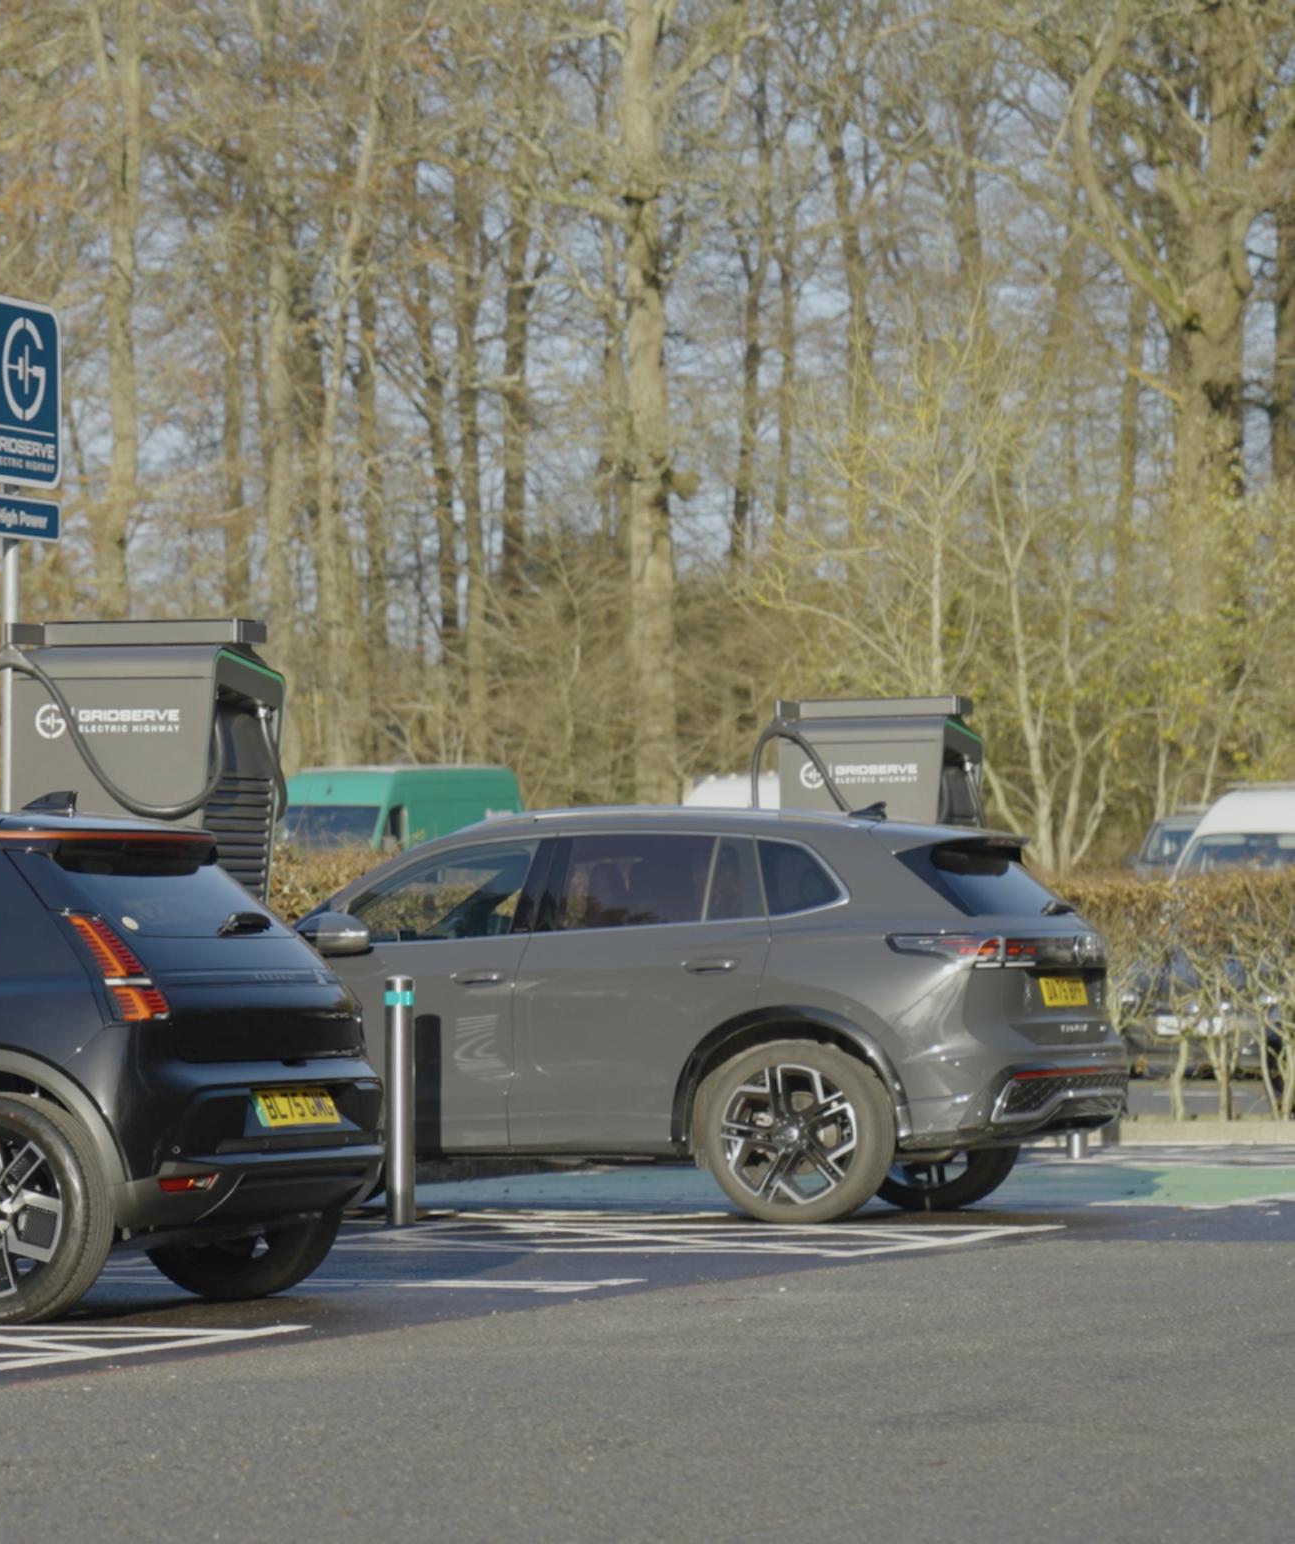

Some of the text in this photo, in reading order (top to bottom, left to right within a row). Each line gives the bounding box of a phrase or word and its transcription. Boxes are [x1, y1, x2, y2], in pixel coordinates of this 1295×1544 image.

[25, 460, 55, 474] HIGHWAY
[19, 510, 48, 529] Power
[78, 709, 180, 722] GRIDSERVE
[78, 724, 180, 733] ELECTRIC HIGHWAY
[835, 763, 918, 775] GRIDSERVE
[835, 776, 876, 784] ELECTRIC
[261, 1092, 306, 1120] BL75
